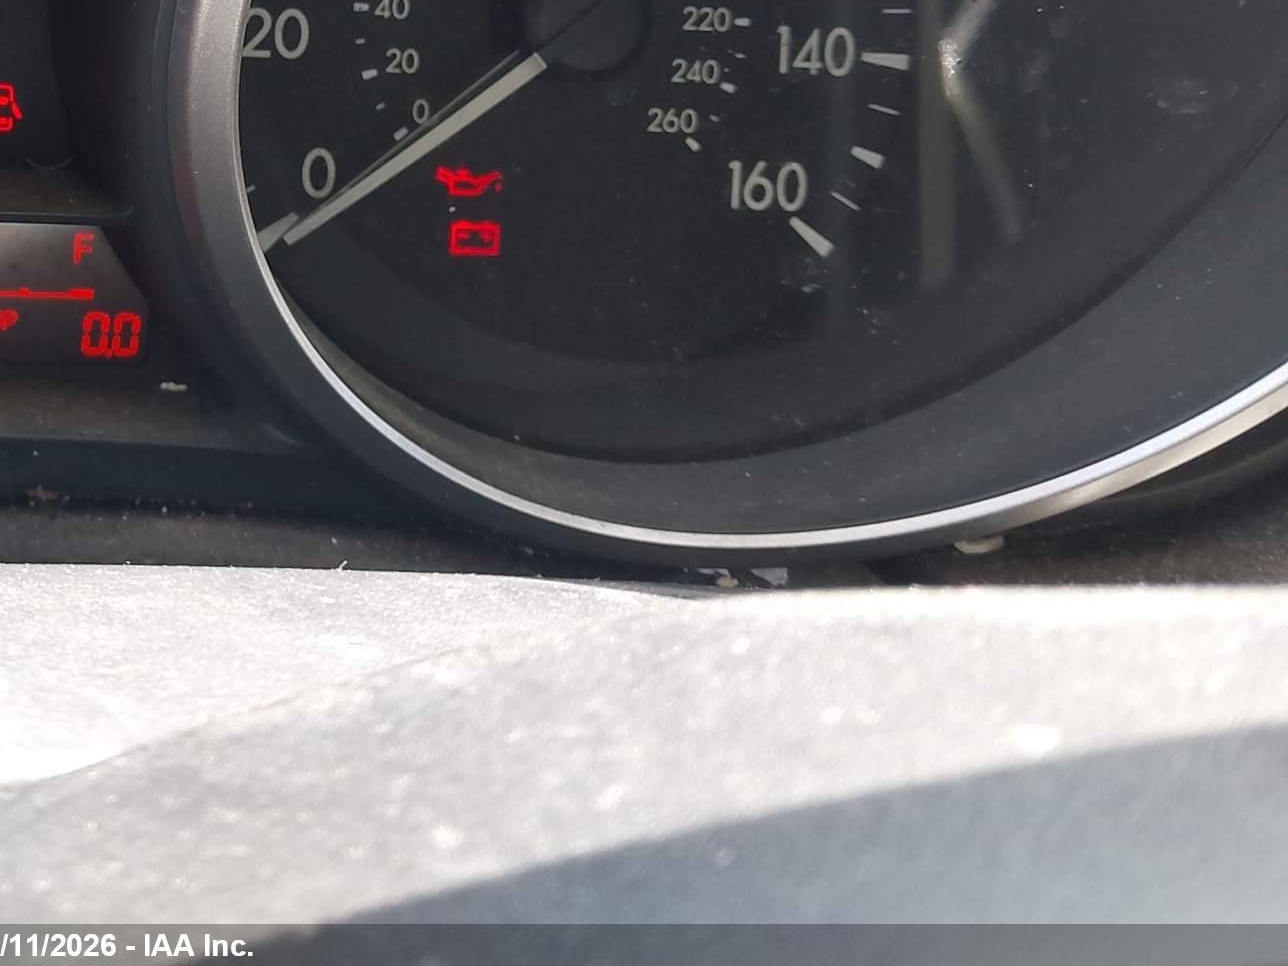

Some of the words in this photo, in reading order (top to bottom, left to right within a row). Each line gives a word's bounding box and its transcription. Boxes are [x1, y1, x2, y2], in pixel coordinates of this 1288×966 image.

[242, 7, 309, 60] 20
[682, 6, 730, 33] 220
[385, 48, 420, 76] 20
[777, 26, 854, 77] 140
[671, 59, 720, 85] 240
[412, 98, 430, 126] 0
[647, 107, 697, 134] 260
[301, 146, 336, 199] 0
[728, 161, 807, 213] 160
[73, 234, 94, 265] F
